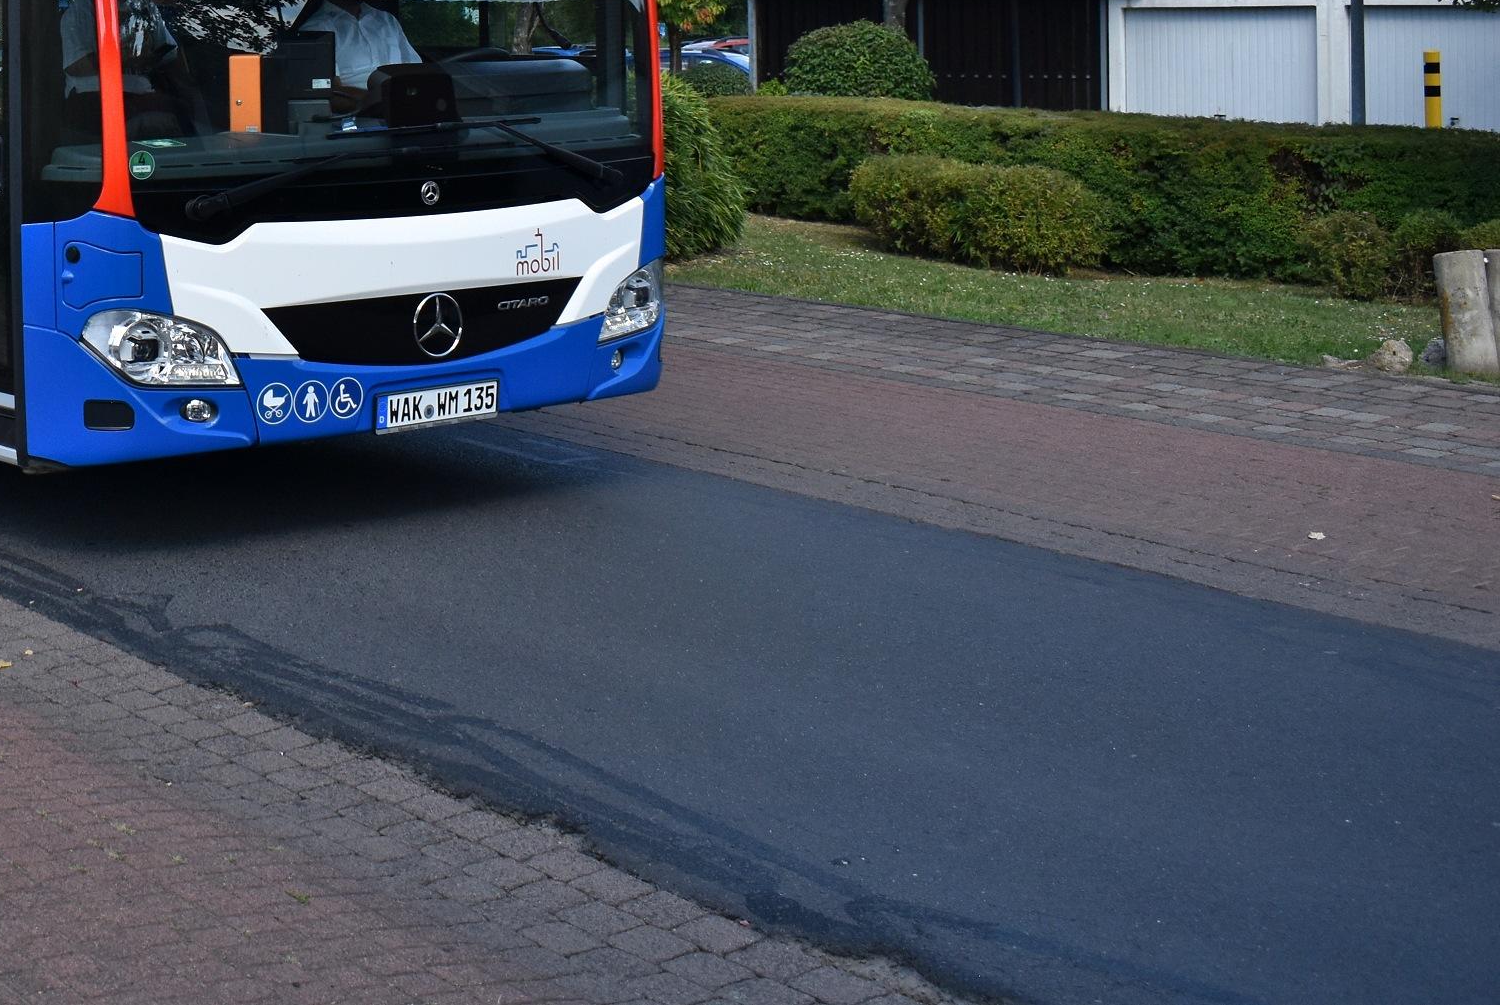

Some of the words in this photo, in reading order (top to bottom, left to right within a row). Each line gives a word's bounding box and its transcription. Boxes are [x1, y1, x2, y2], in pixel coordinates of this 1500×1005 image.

[516, 235, 560, 276] mobil
[497, 296, 549, 310] CITARO
[390, 395, 422, 424] WAK
[437, 390, 459, 416] WM
[463, 385, 495, 413] 135
